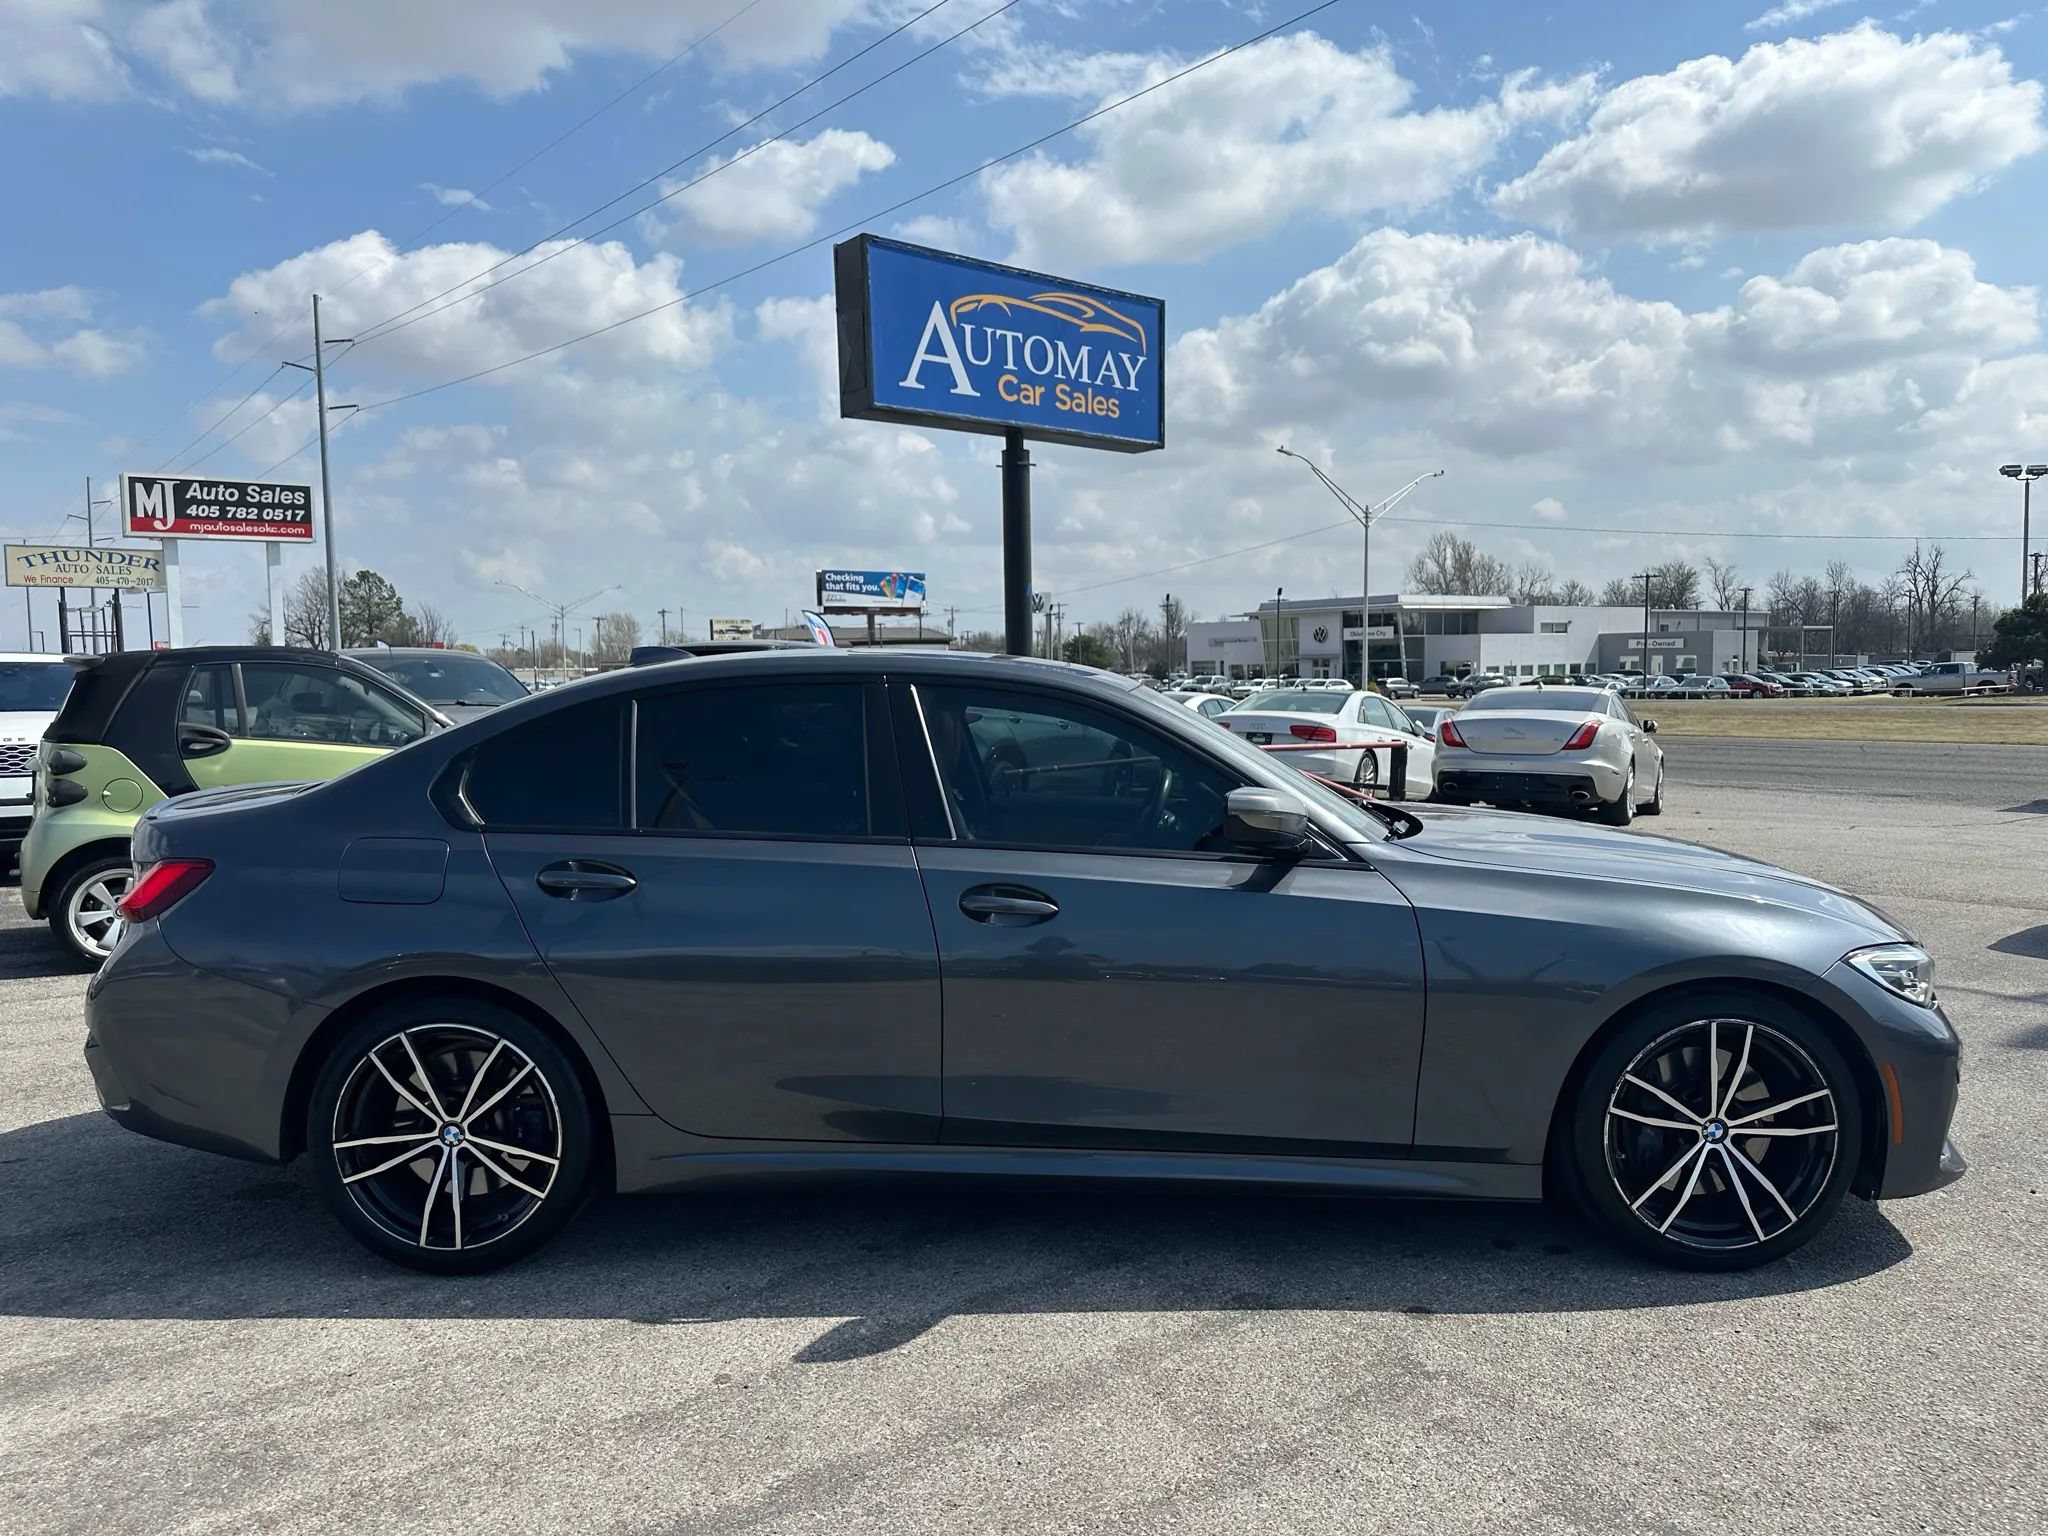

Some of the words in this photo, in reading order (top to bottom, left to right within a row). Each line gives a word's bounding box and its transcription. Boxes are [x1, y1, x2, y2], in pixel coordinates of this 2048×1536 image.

[898, 300, 1147, 397] AUTOMAY
[997, 374, 1045, 407] Car
[1055, 383, 1120, 419] Sales
[185, 482, 240, 502] Auto
[246, 485, 305, 505] Sales
[135, 480, 180, 532] MJ
[186, 504, 220, 518] 405
[226, 506, 258, 520] 782
[263, 508, 305, 522] 0517
[189, 521, 305, 535] mjautosalesokc.com
[17, 550, 161, 573] THUNDER
[55, 563, 89, 574] AUTO
[96, 565, 132, 576] SALES
[23, 574, 37, 584] We
[40, 574, 74, 585] Finance
[95, 576, 154, 586] 405-470-2017
[825, 572, 864, 584] Checking
[825, 582, 844, 591] that
[846, 582, 860, 591] fits
[862, 584, 880, 593] you.
